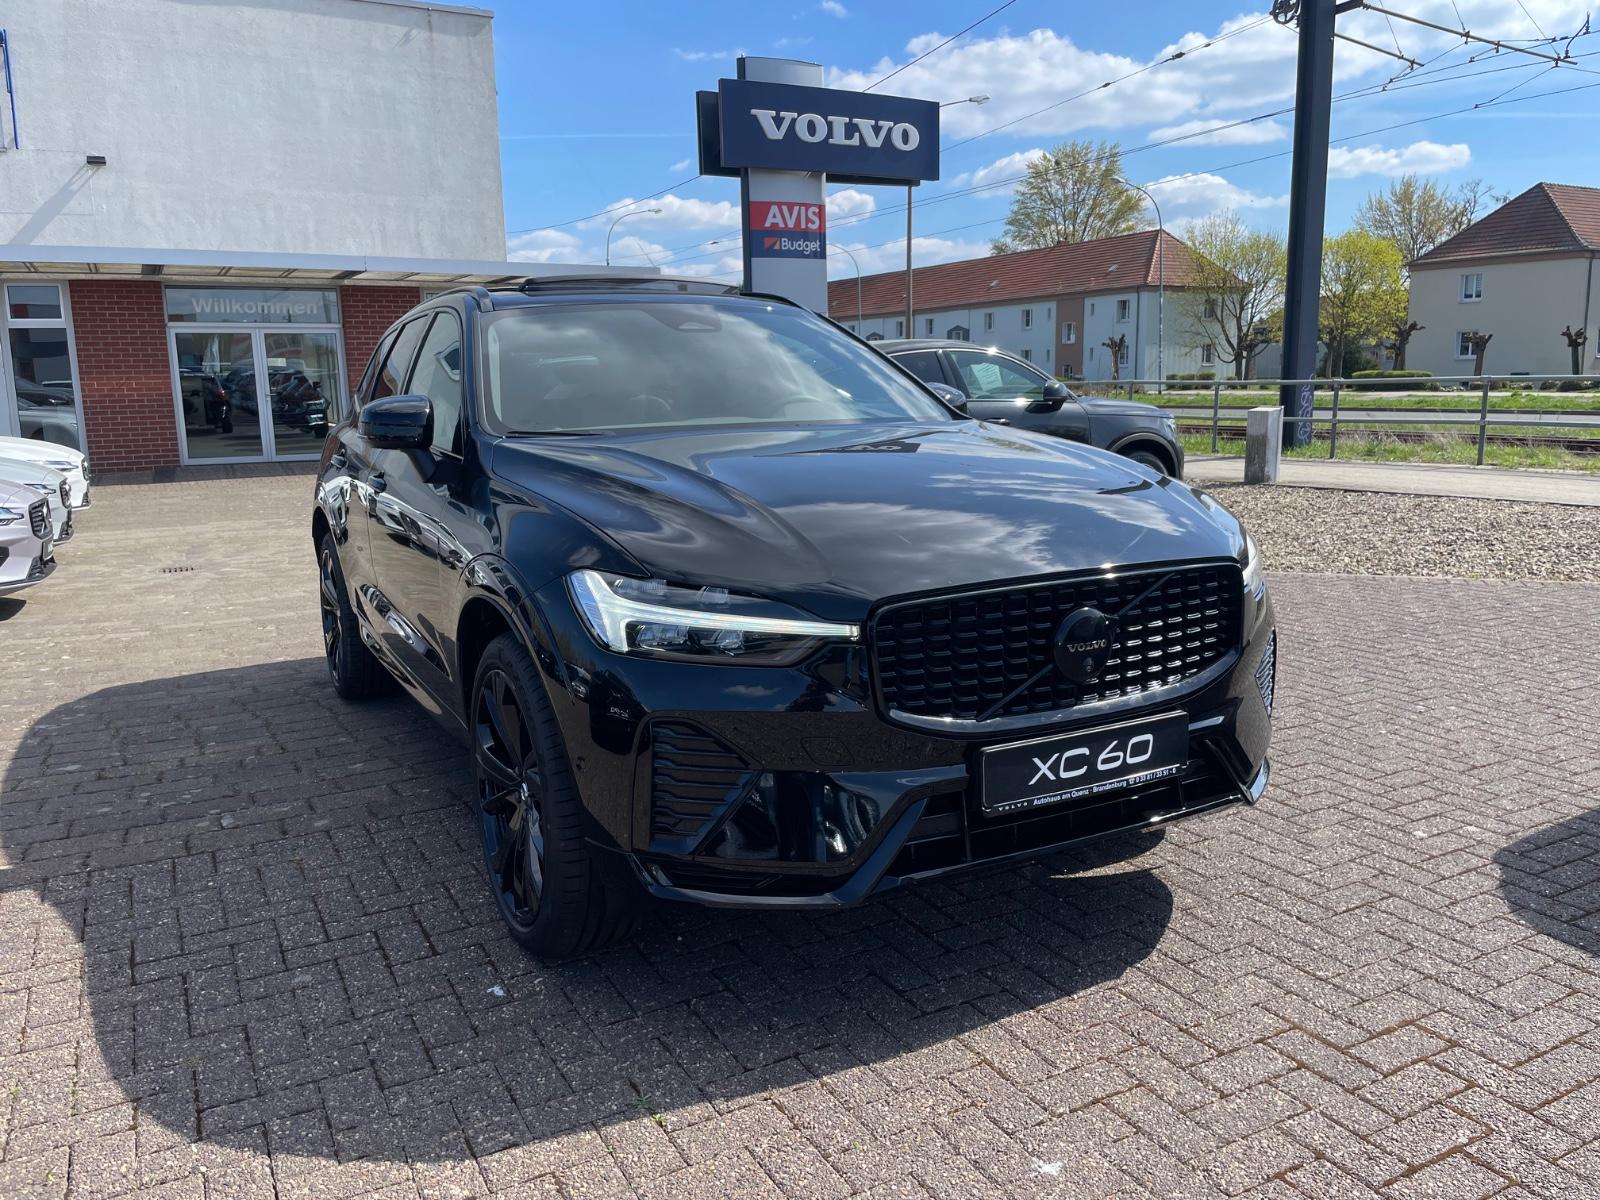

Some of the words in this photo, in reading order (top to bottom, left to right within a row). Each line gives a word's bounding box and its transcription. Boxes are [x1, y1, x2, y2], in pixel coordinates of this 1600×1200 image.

[750, 109, 920, 151] VOLVO
[764, 204, 820, 230] AVIS
[781, 238, 820, 254] Budget
[192, 298, 318, 314] Willkommen
[1067, 640, 1107, 652] VOLVO
[1028, 748, 1090, 786] XC
[1096, 734, 1154, 770] 60
[1033, 796, 1060, 806] Autohaus
[1093, 780, 1127, 793] Brandenburg
